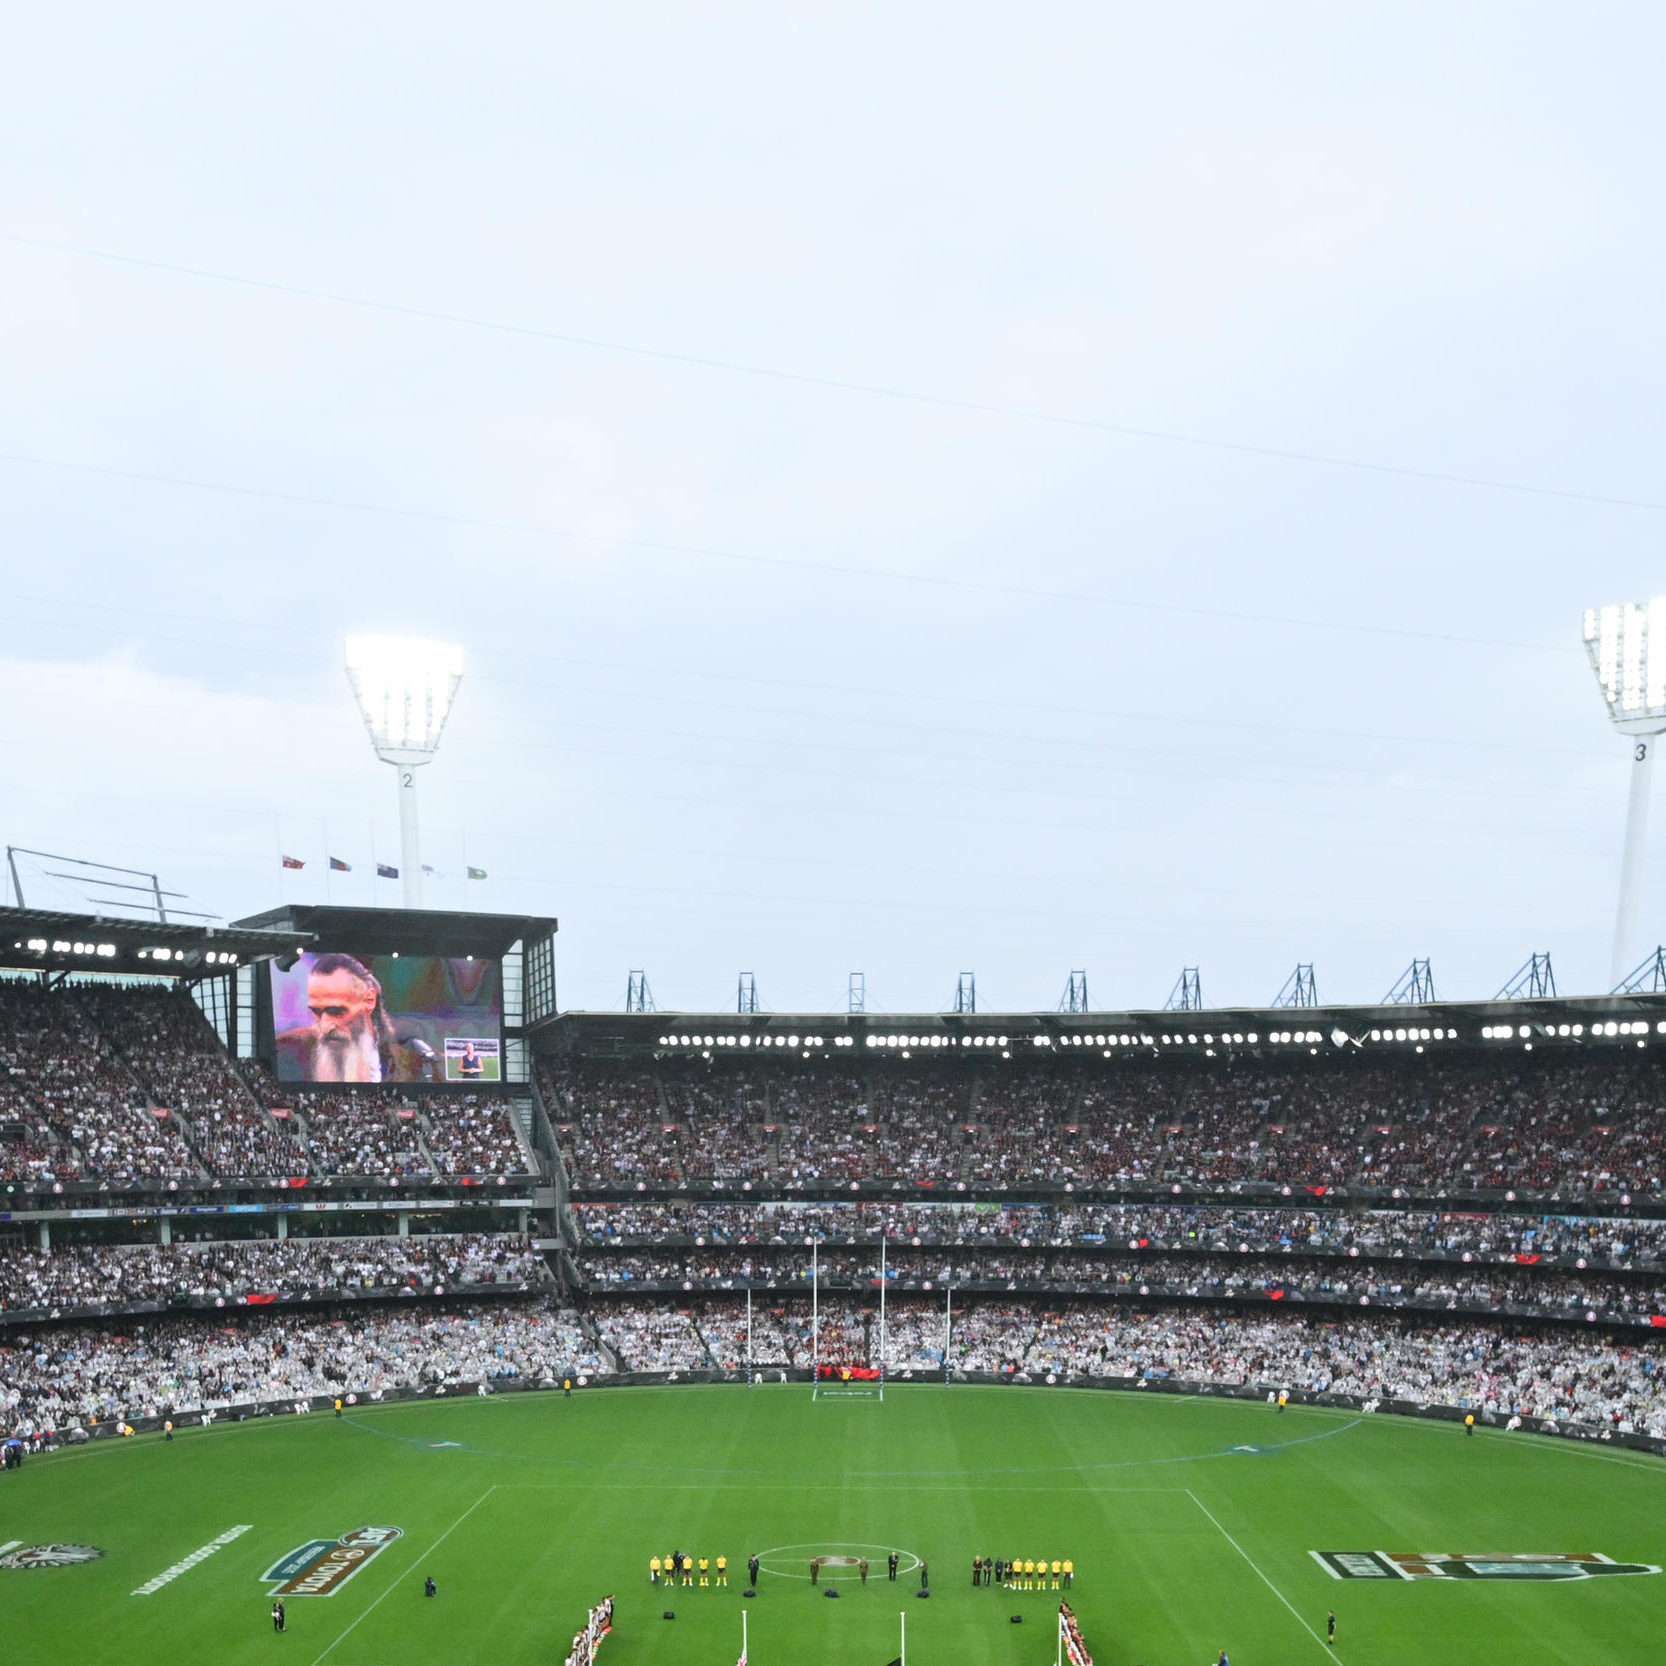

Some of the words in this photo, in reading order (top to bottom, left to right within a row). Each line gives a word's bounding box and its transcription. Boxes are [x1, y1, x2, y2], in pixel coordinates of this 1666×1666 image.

[1635, 743, 1647, 762] 3
[402, 773, 413, 788] 2
[289, 1560, 350, 1593] TOYOTA
